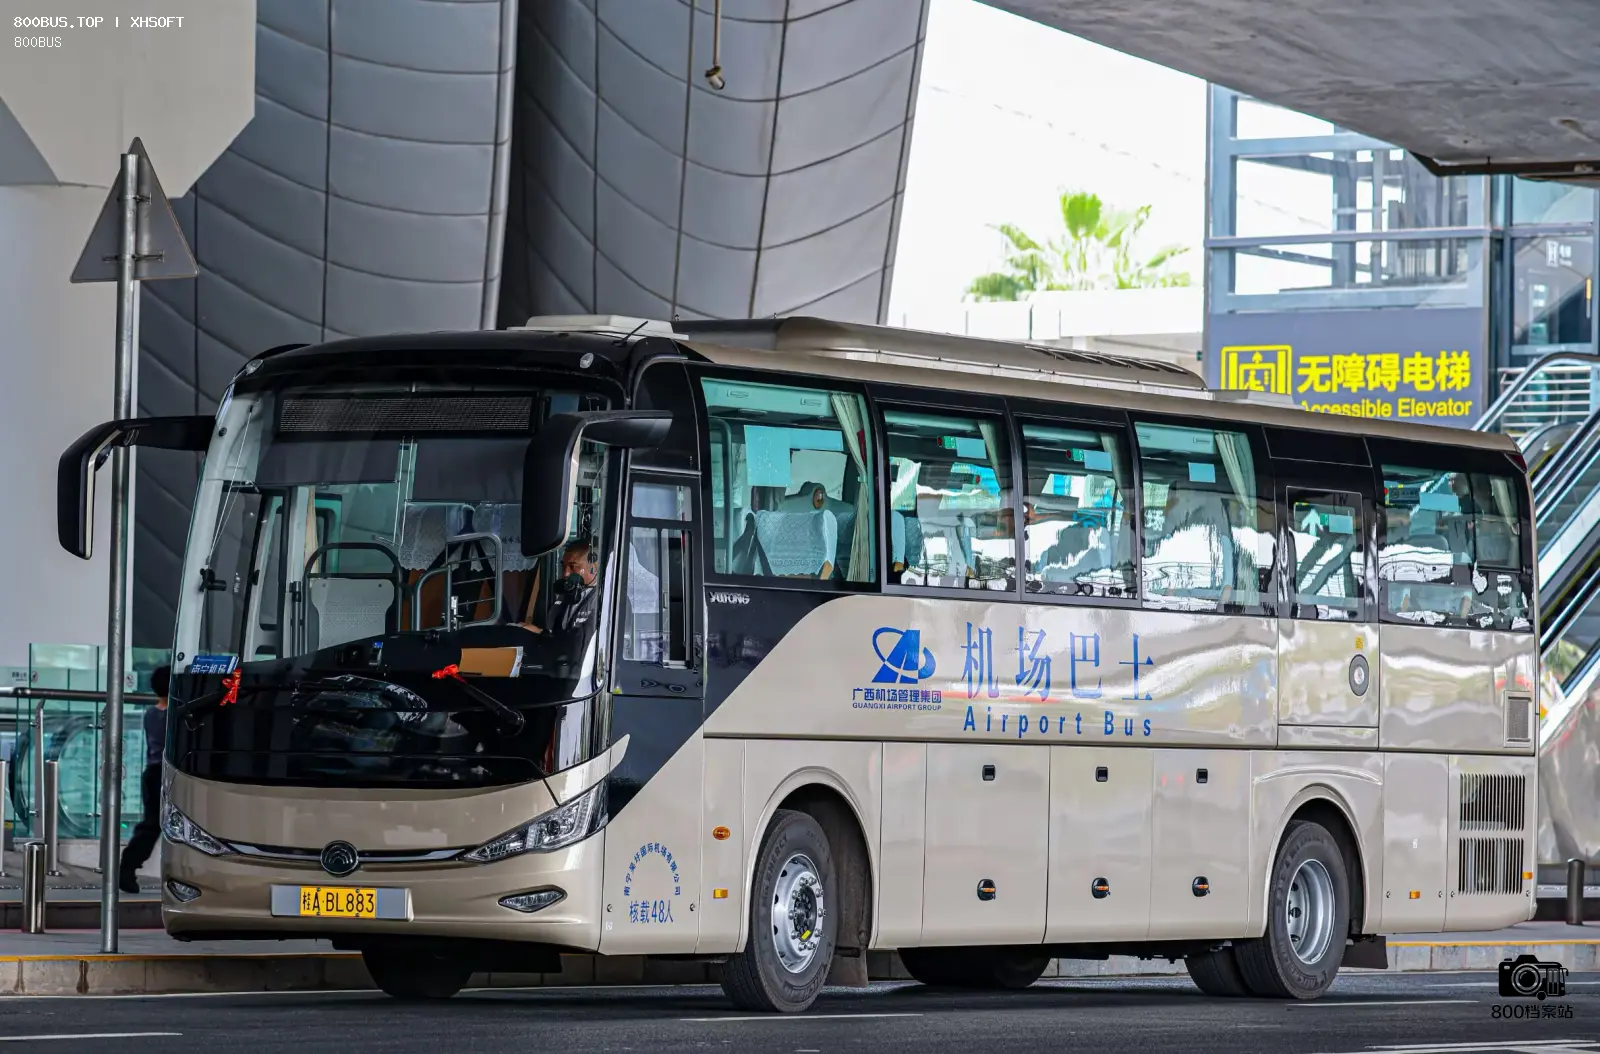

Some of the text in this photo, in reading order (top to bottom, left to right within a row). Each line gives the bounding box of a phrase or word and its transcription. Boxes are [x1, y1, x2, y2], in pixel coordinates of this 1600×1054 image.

[1297, 351, 1471, 393] 无障碍电梯
[1398, 398, 1472, 418] Elevator
[960, 621, 1154, 702] 机场巴士
[852, 687, 942, 703] 广西机场管理集团
[852, 702, 886, 710] GUANGXI
[963, 705, 1151, 738] Airport Bus
[629, 900, 674, 923] 核载48人
